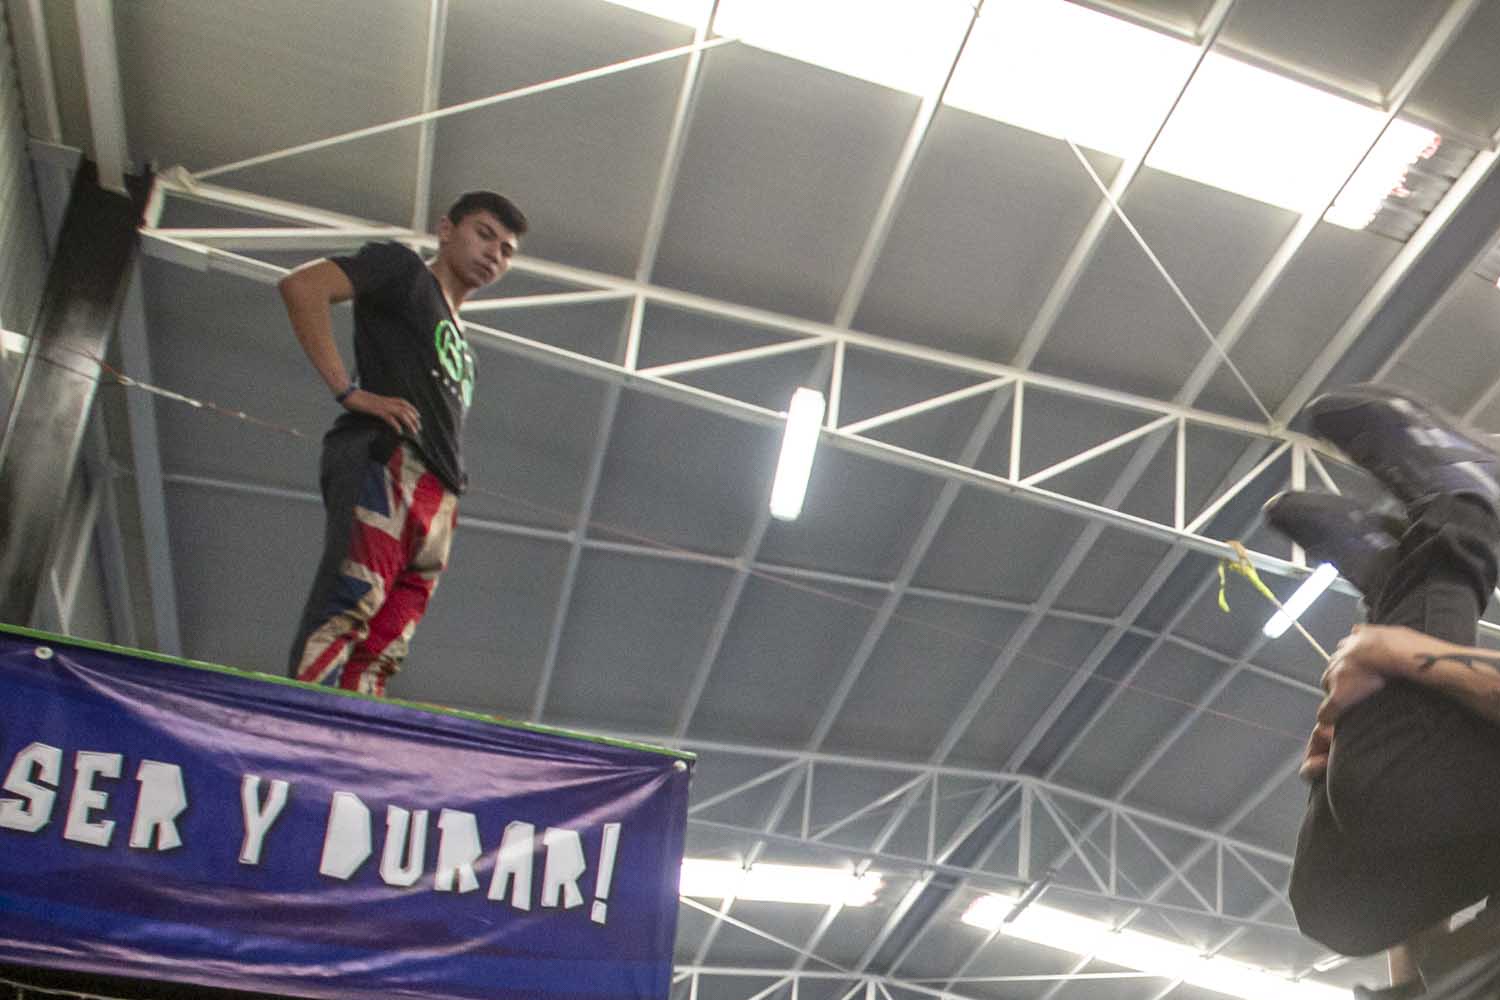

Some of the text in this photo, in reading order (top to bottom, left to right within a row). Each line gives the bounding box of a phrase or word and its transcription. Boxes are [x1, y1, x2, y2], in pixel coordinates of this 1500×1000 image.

[0, 741, 621, 924] SER Y DURAR!
